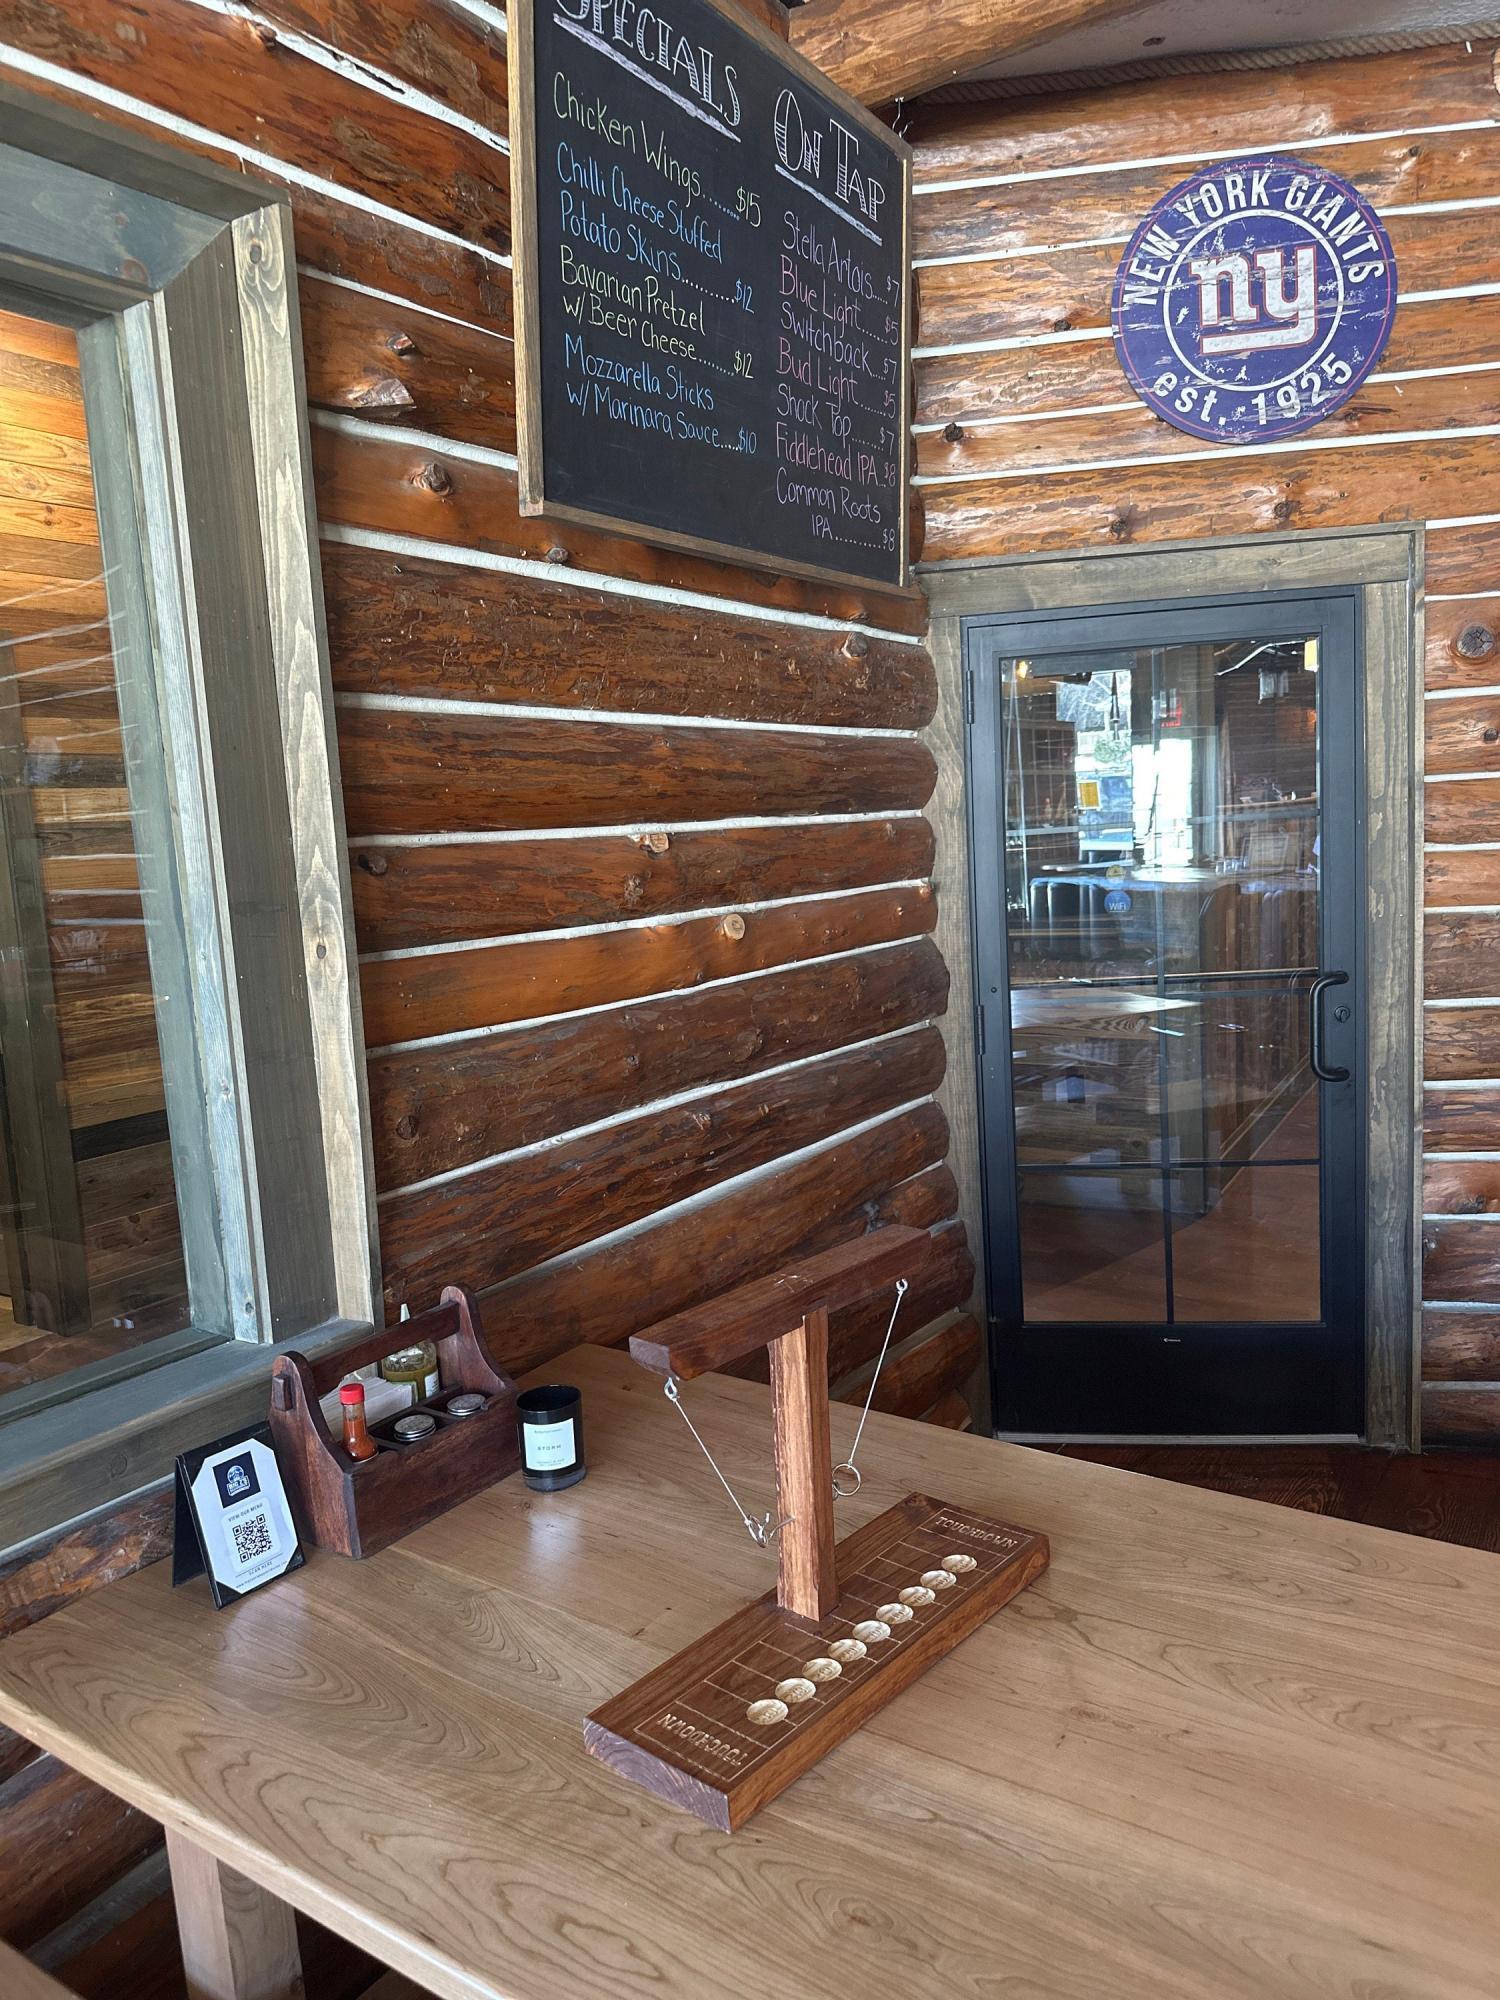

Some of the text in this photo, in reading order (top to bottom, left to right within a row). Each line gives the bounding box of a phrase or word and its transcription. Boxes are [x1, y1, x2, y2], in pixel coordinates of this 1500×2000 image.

[553, 71, 636, 154] Chicken
[735, 186, 761, 227] $15
[557, 142, 722, 264] Chilli Cheese Stuffed
[1122, 169, 1385, 305] NEW YORK GIANTS
[560, 190, 621, 253] Potato
[735, 277, 755, 314] $12
[560, 244, 706, 336] Bavarian Pretzel
[782, 211, 825, 273] Stella
[886, 275, 900, 307] $7
[589, 293, 638, 339] Beer
[734, 350, 754, 379] $12
[779, 254, 899, 345] Blue Light $5
[565, 333, 714, 411] Mozzarella Sticks
[776, 336, 896, 419] Bud Light $5
[883, 358, 897, 385] $7
[1154, 352, 1353, 426] est. 1925
[594, 383, 674, 440] Marinara
[738, 427, 757, 454] $10
[776, 383, 895, 456] Shock Top $7
[776, 421, 896, 487] Fiddlehead IPA $8
[776, 467, 881, 523] Common Roots
[812, 514, 895, 551] IPA $8
[935, 1516, 1018, 1548] TOUCHDOWN
[656, 1713, 748, 1766] TOUCHDOWN
